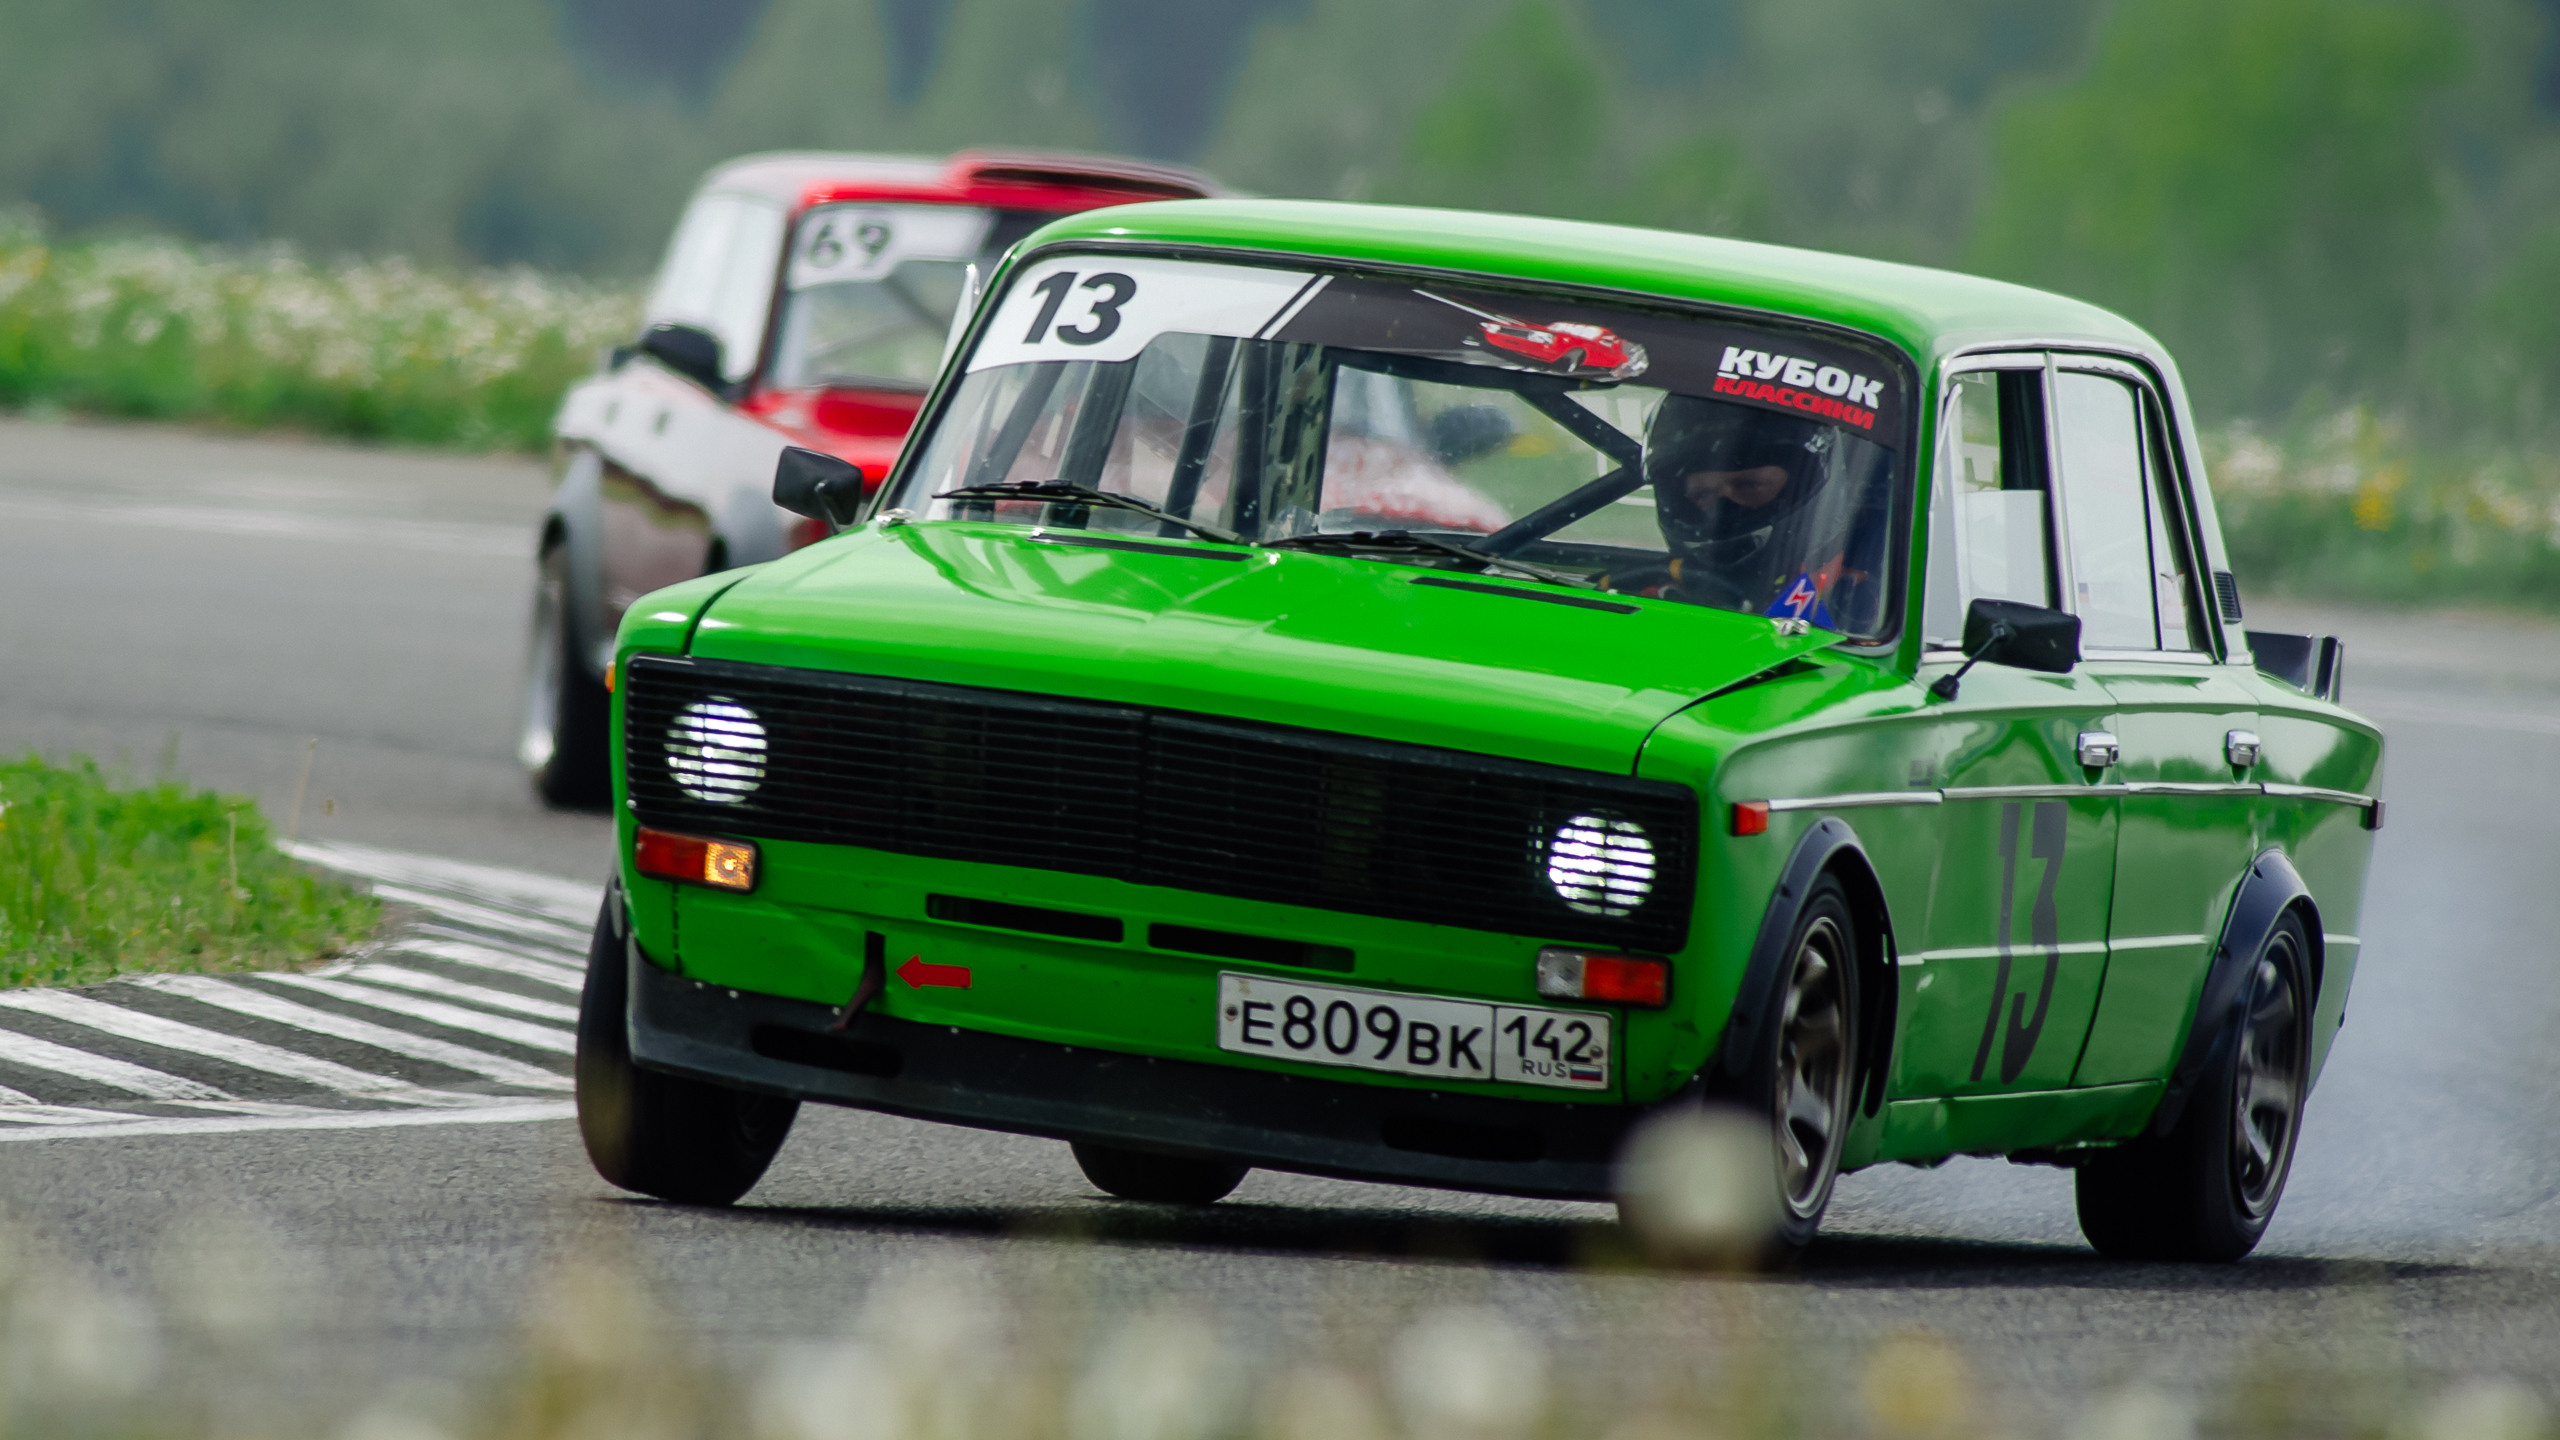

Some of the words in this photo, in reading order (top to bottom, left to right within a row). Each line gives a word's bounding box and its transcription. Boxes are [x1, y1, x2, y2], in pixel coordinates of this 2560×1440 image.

[807, 222, 891, 267] 69
[1021, 271, 1137, 346] 13
[1712, 376, 1877, 430] КЛАССИКИ
[1717, 346, 1885, 410] КУБОК
[1969, 801, 2068, 1085] 13
[1503, 1015, 1593, 1064] 142
[1521, 1059, 1568, 1078] RUS
